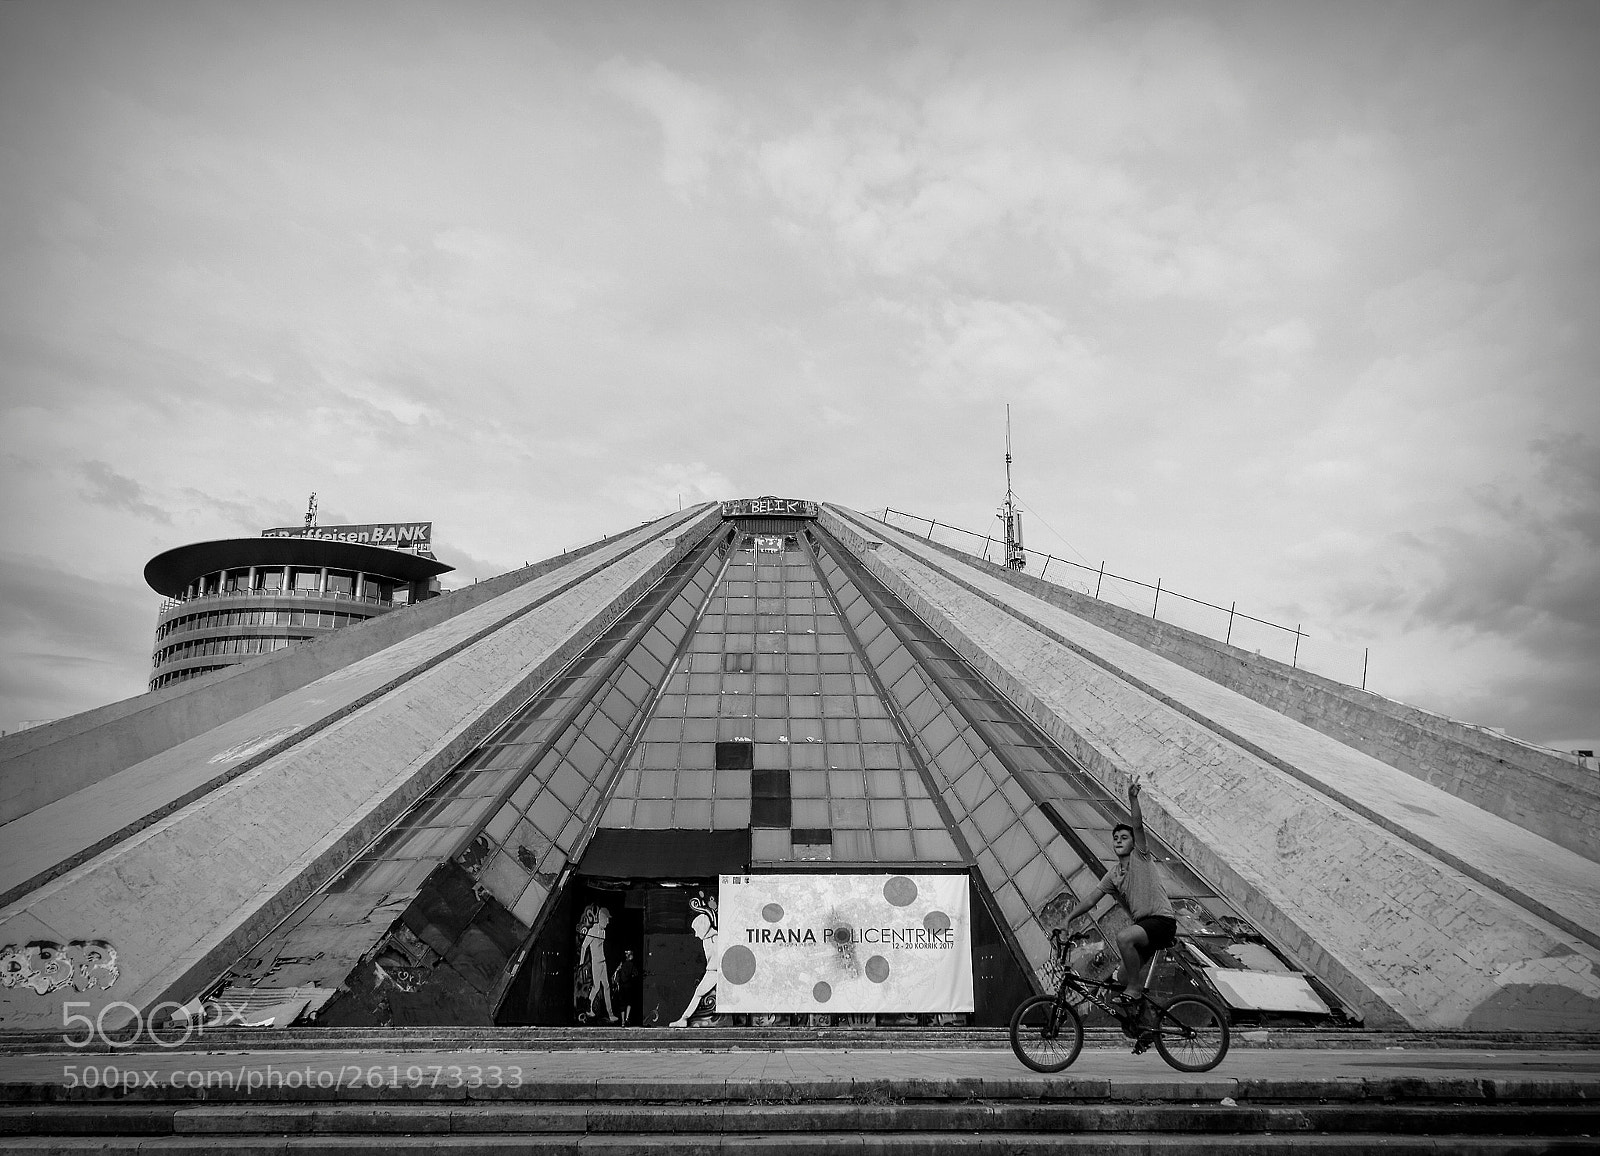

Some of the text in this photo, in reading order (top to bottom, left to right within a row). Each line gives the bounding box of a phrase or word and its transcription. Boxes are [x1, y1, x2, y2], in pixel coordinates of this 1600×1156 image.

[751, 499, 799, 513] BELIK
[371, 526, 428, 542] BANK
[746, 928, 817, 943] TIRANA
[892, 942, 900, 950] 12
[905, 942, 913, 950] 20
[914, 942, 938, 950] KORRIK
[939, 942, 954, 950] 2017
